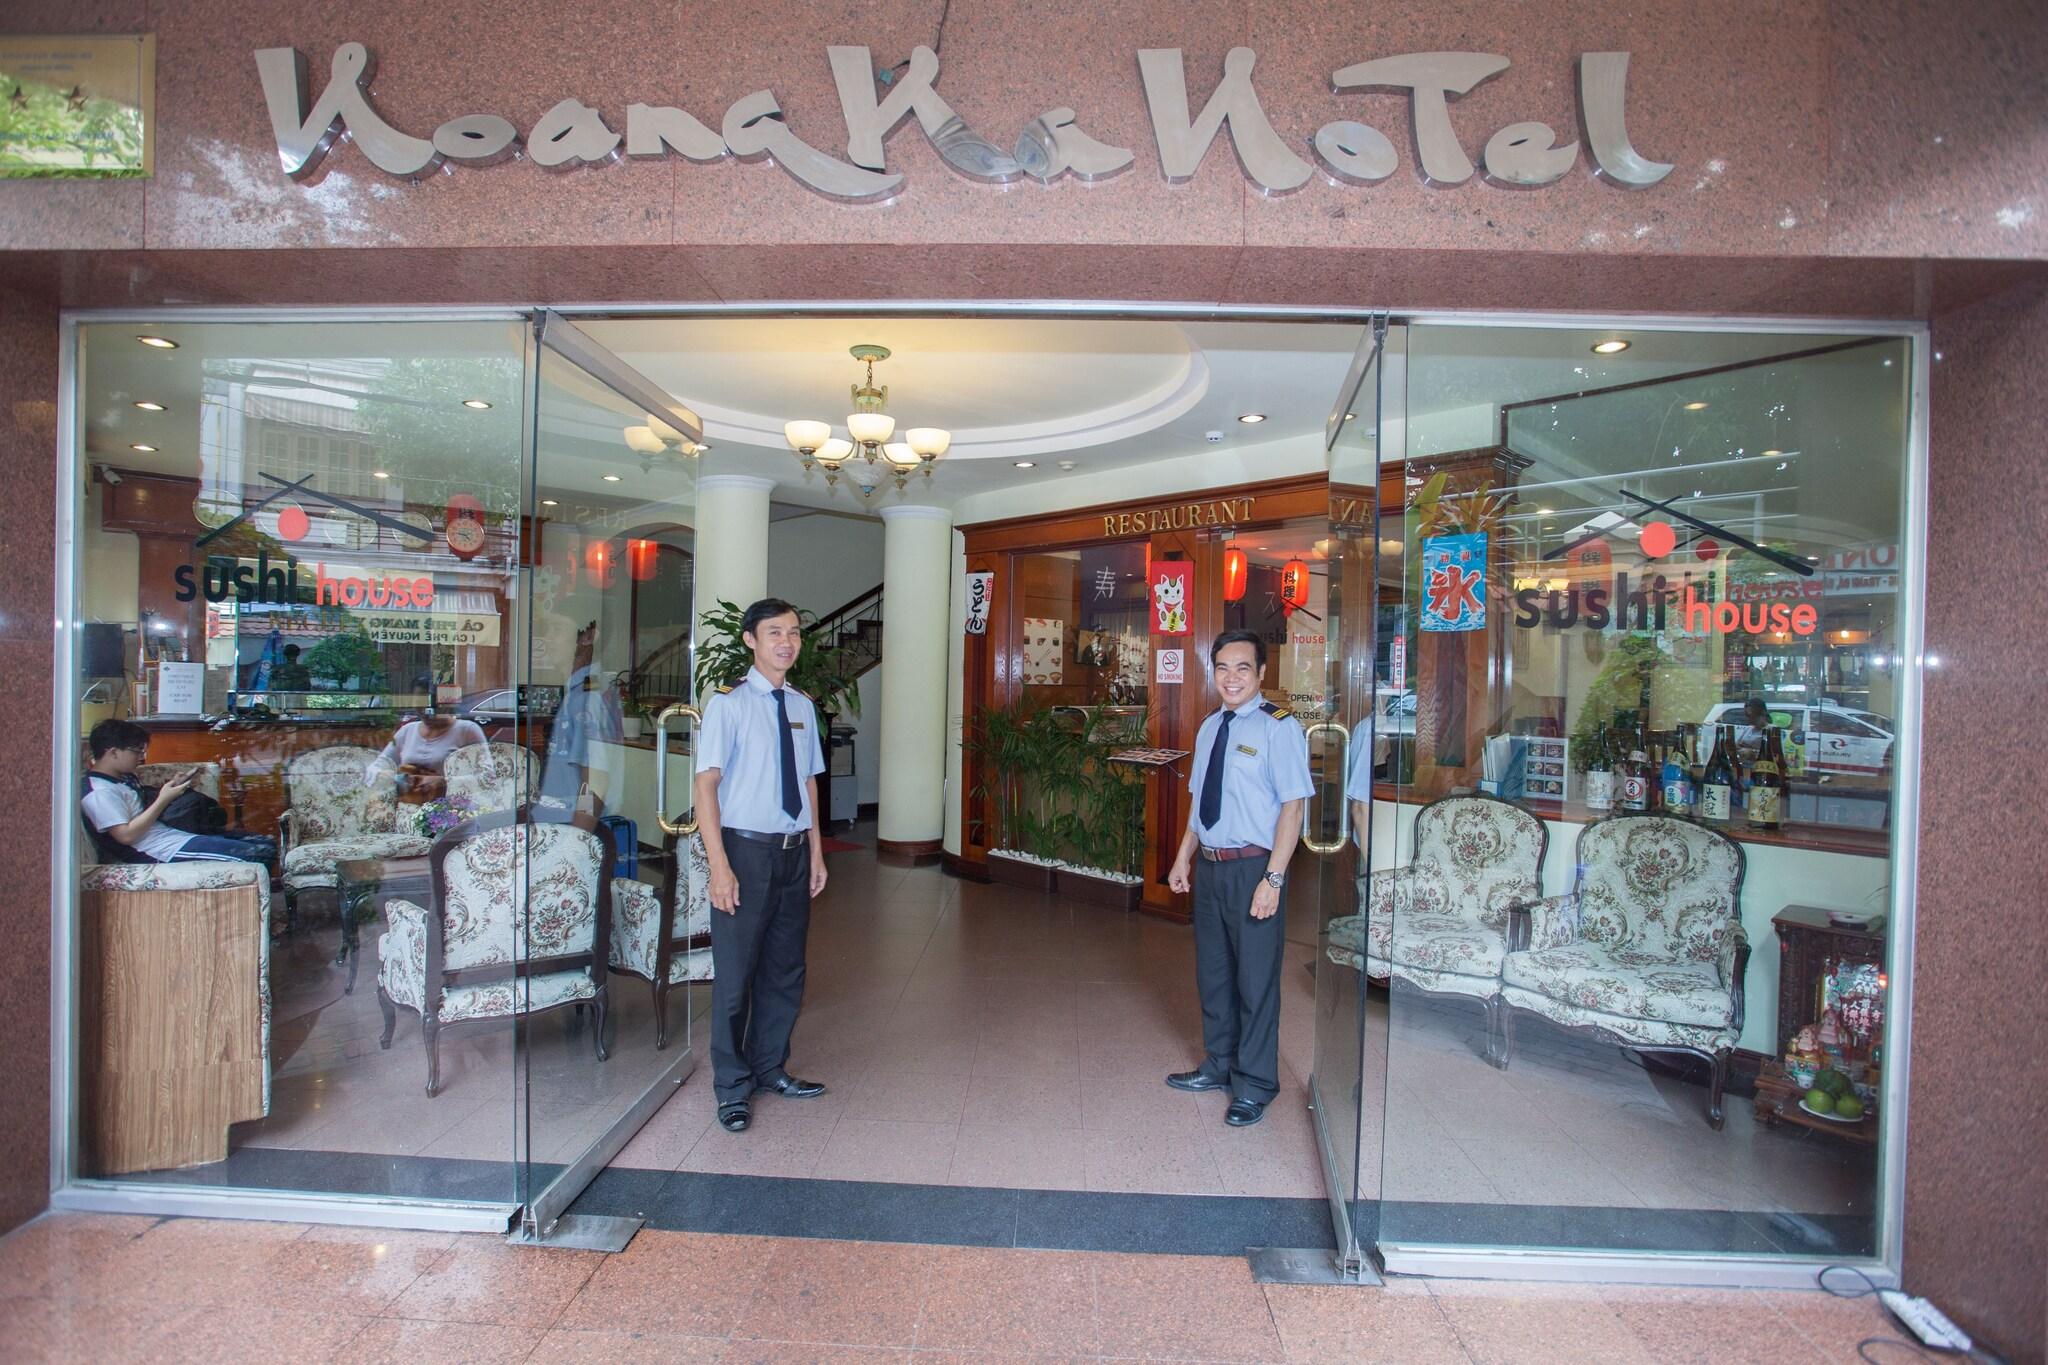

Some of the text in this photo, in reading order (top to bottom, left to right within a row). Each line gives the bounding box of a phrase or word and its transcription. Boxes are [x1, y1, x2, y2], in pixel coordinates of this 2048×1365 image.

[1103, 498, 1256, 537] RESTAURANT
[174, 550, 435, 608] sushi house
[970, 578, 985, 631] うどん
[1427, 565, 1484, 621] 氷
[1515, 572, 1666, 631] sushi
[1685, 585, 1819, 636] house
[1292, 631, 1325, 644] house
